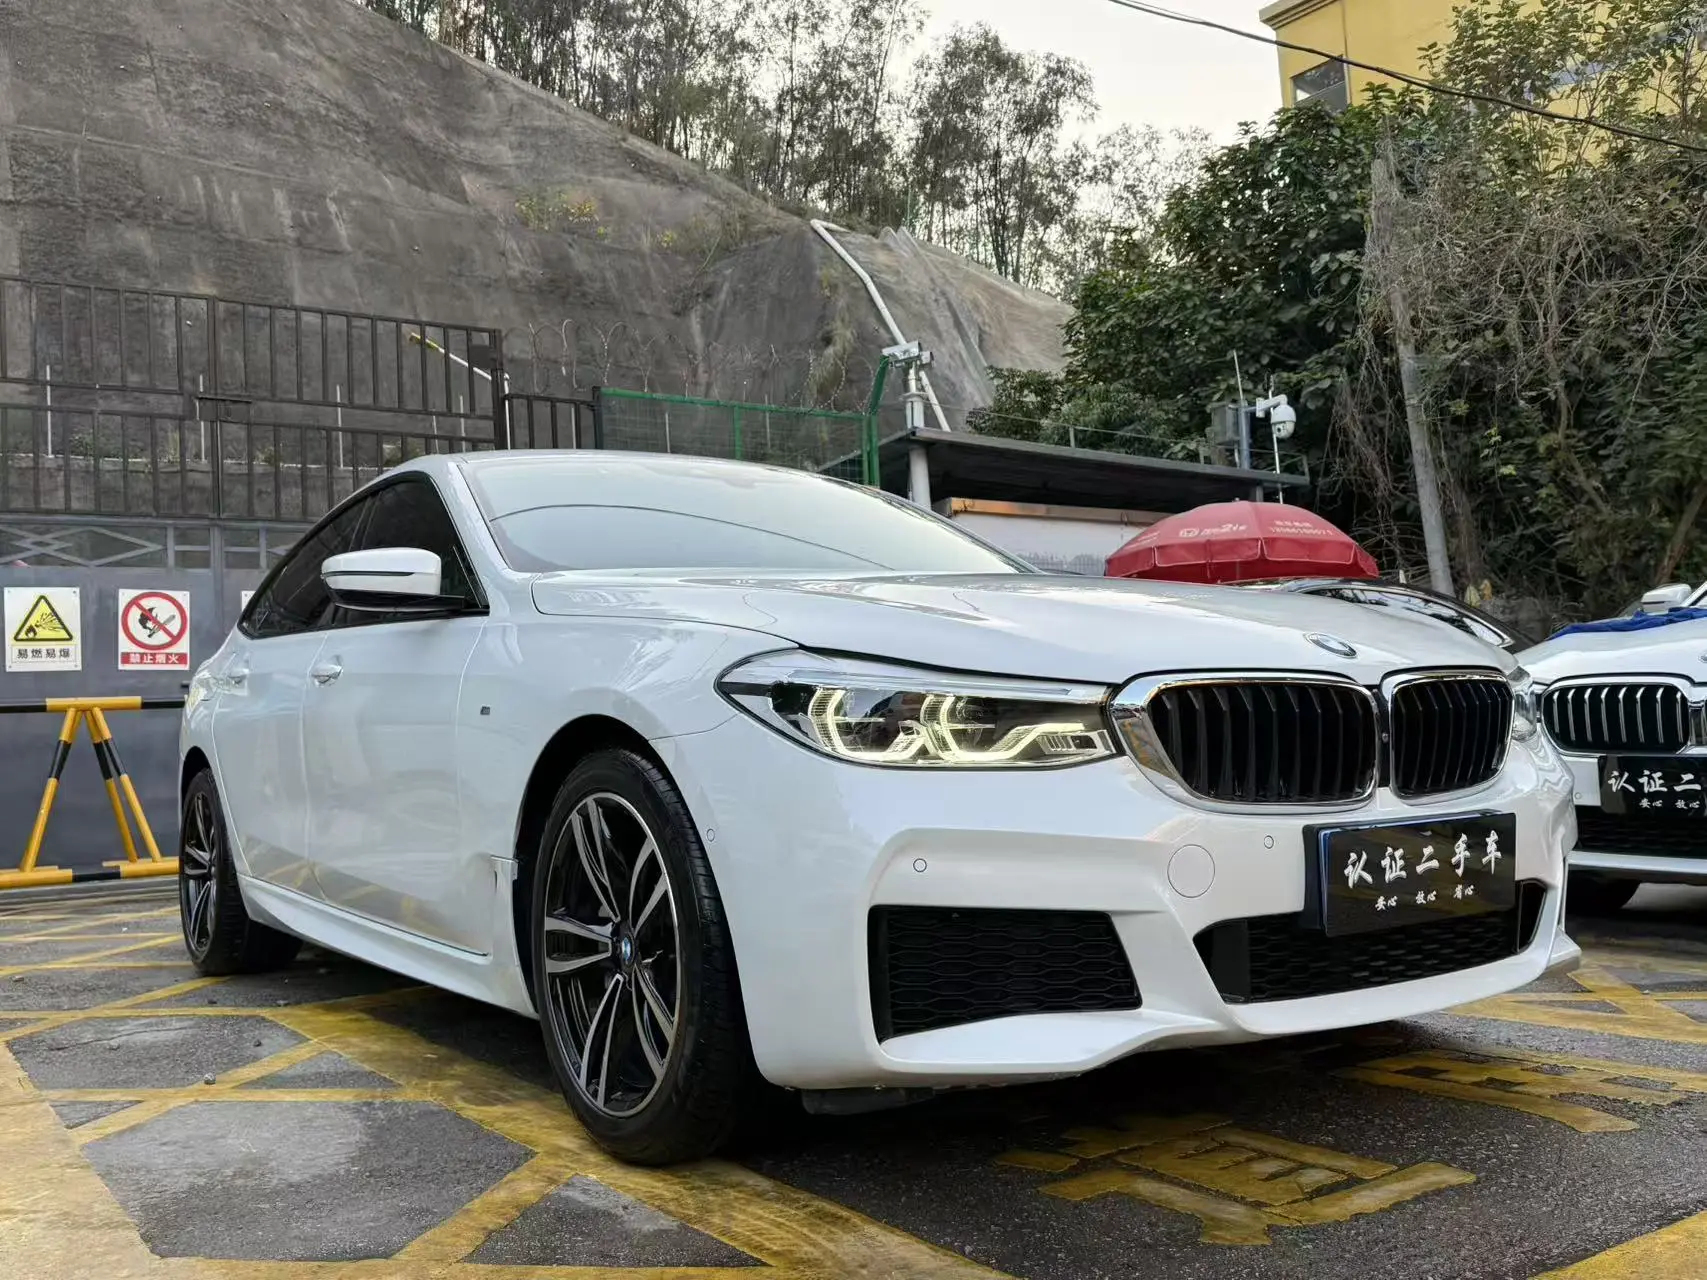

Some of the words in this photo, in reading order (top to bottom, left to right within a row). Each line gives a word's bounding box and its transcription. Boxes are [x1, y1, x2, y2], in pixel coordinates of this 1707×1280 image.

[17, 648, 71, 659] 易燃易爆
[129, 653, 180, 664] 禁止烟火
[1344, 830, 1502, 889] 认证二手车
[1375, 895, 1398, 911] 安心
